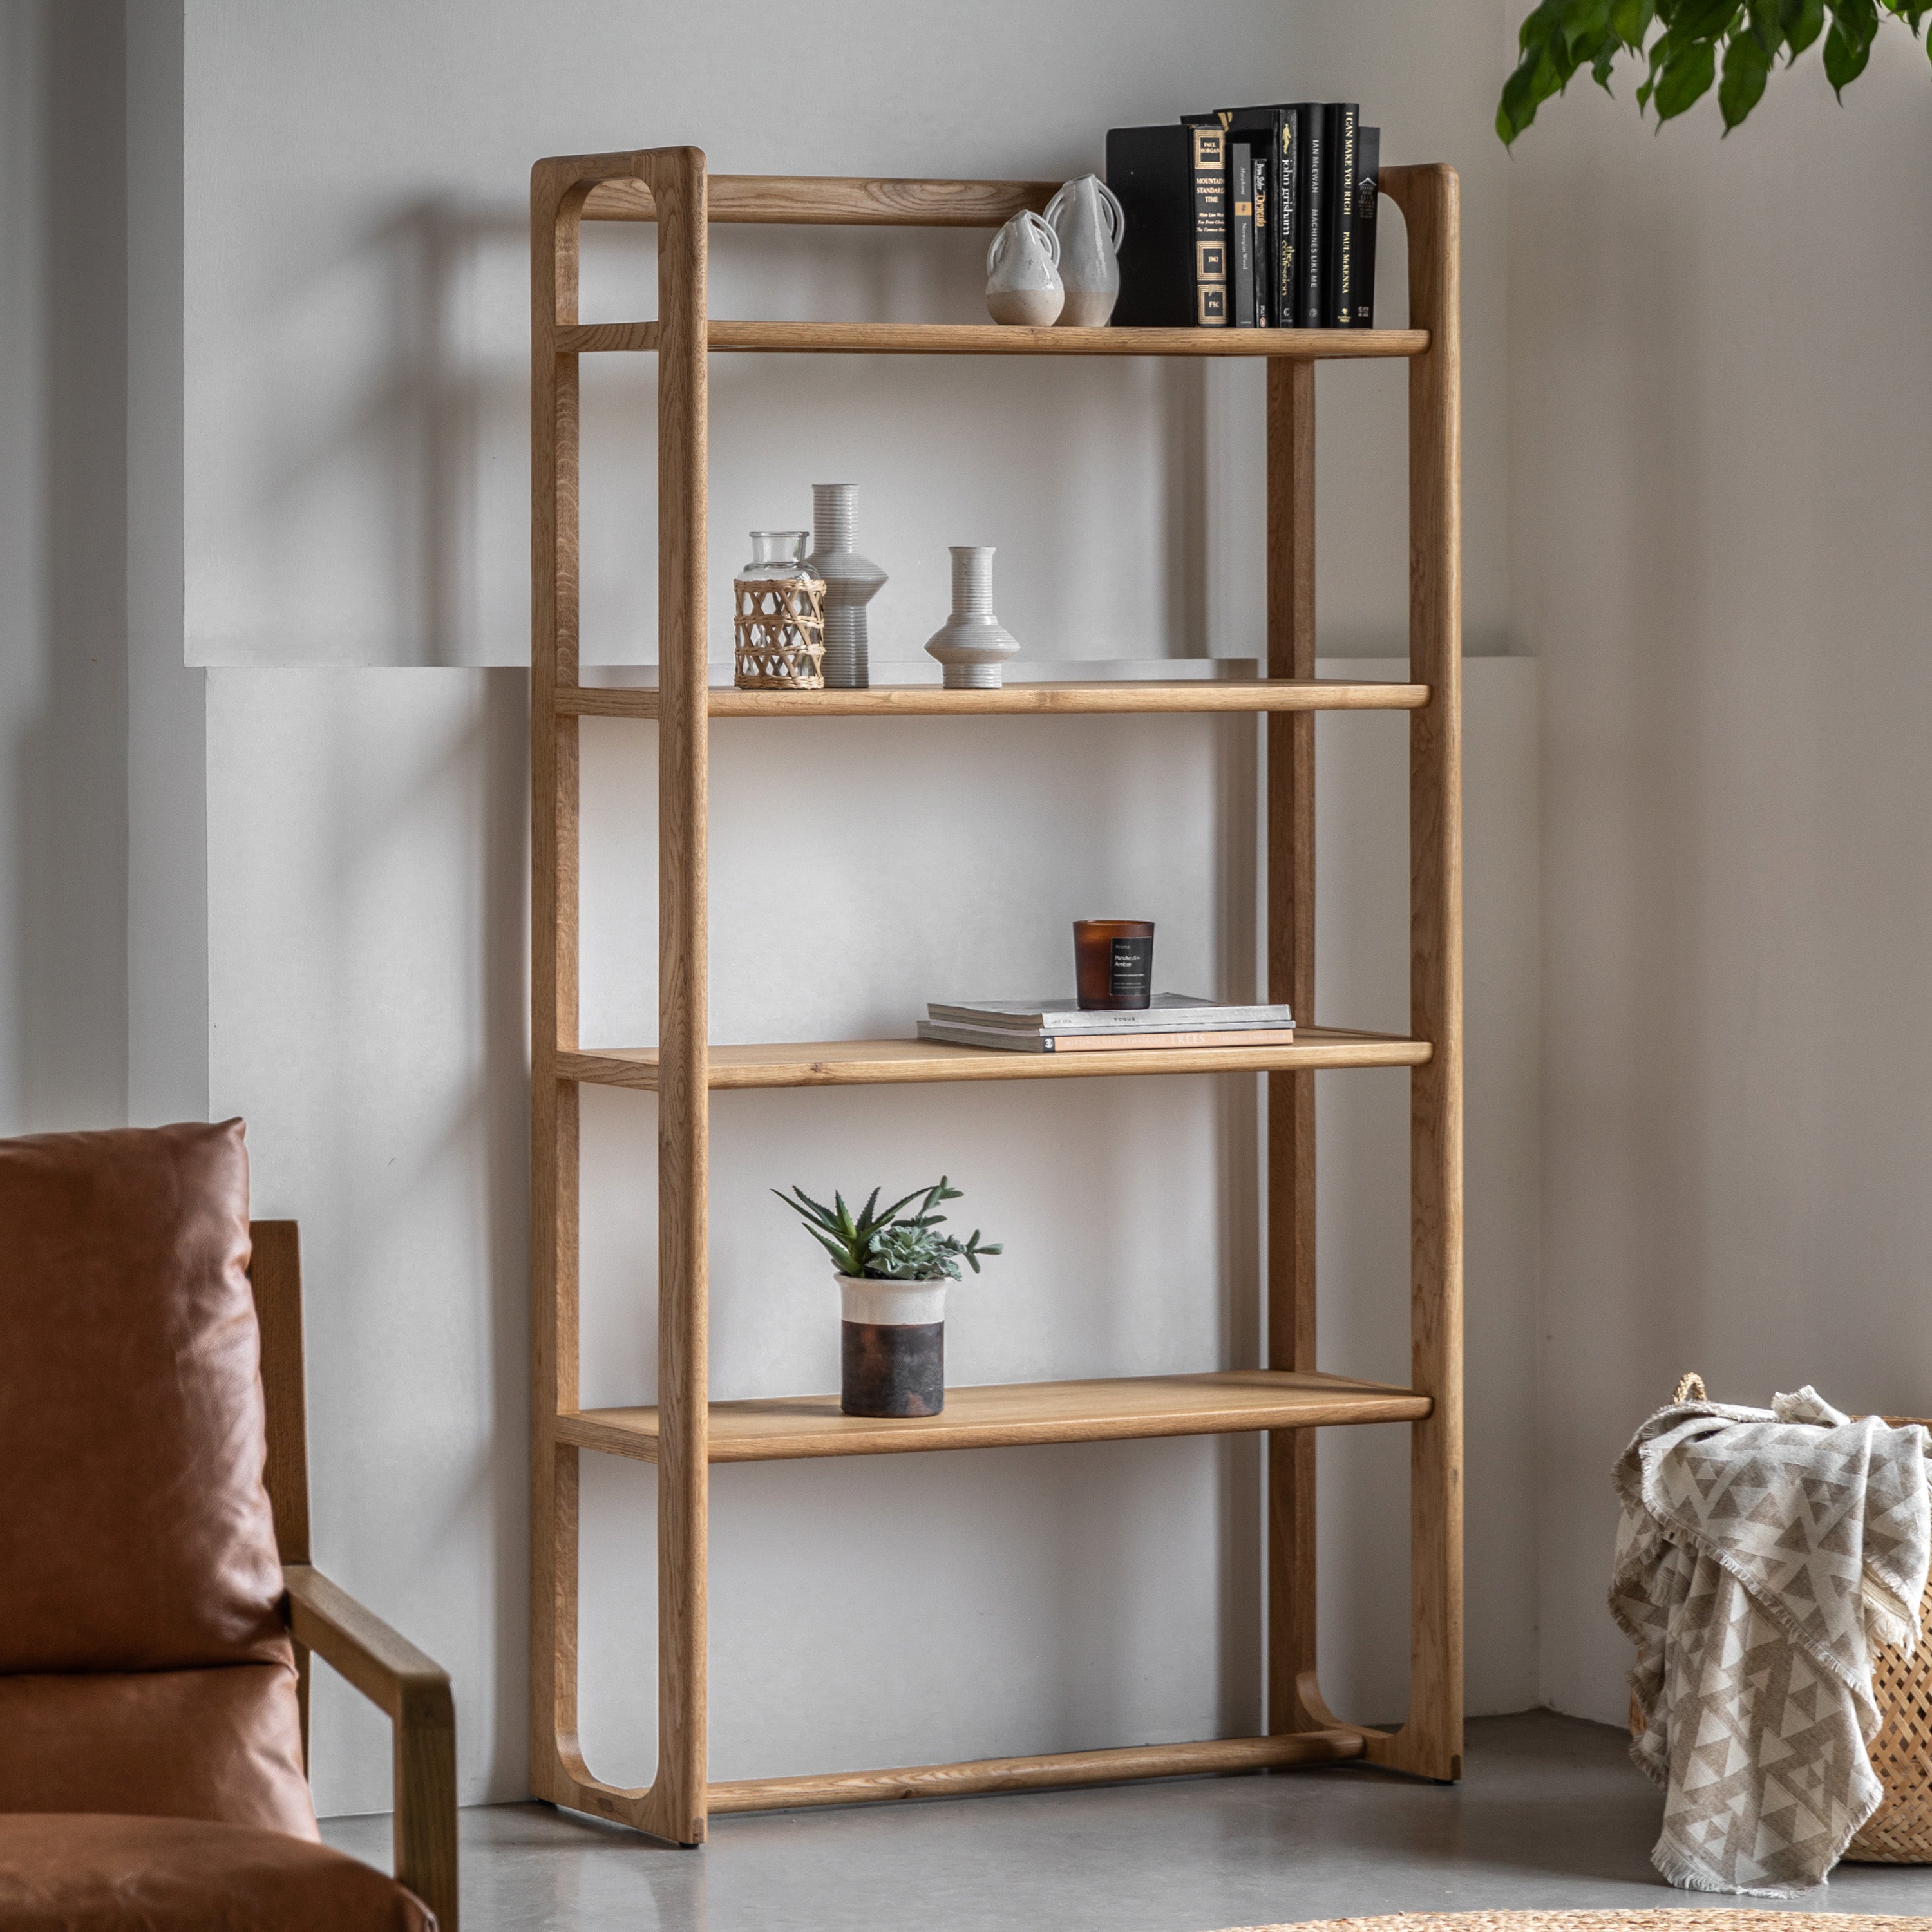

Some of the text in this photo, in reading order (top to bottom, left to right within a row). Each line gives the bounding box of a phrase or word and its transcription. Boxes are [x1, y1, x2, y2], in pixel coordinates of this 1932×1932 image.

[1345, 139, 1353, 166] MAKE
[1344, 168, 1352, 189] YOU
[1256, 190, 1267, 227] Dracula
[1282, 160, 1293, 235] john grisham
[1343, 191, 1352, 215] RICH
[1311, 275, 1318, 288] ME
[1169, 1034, 1205, 1045] TREES
